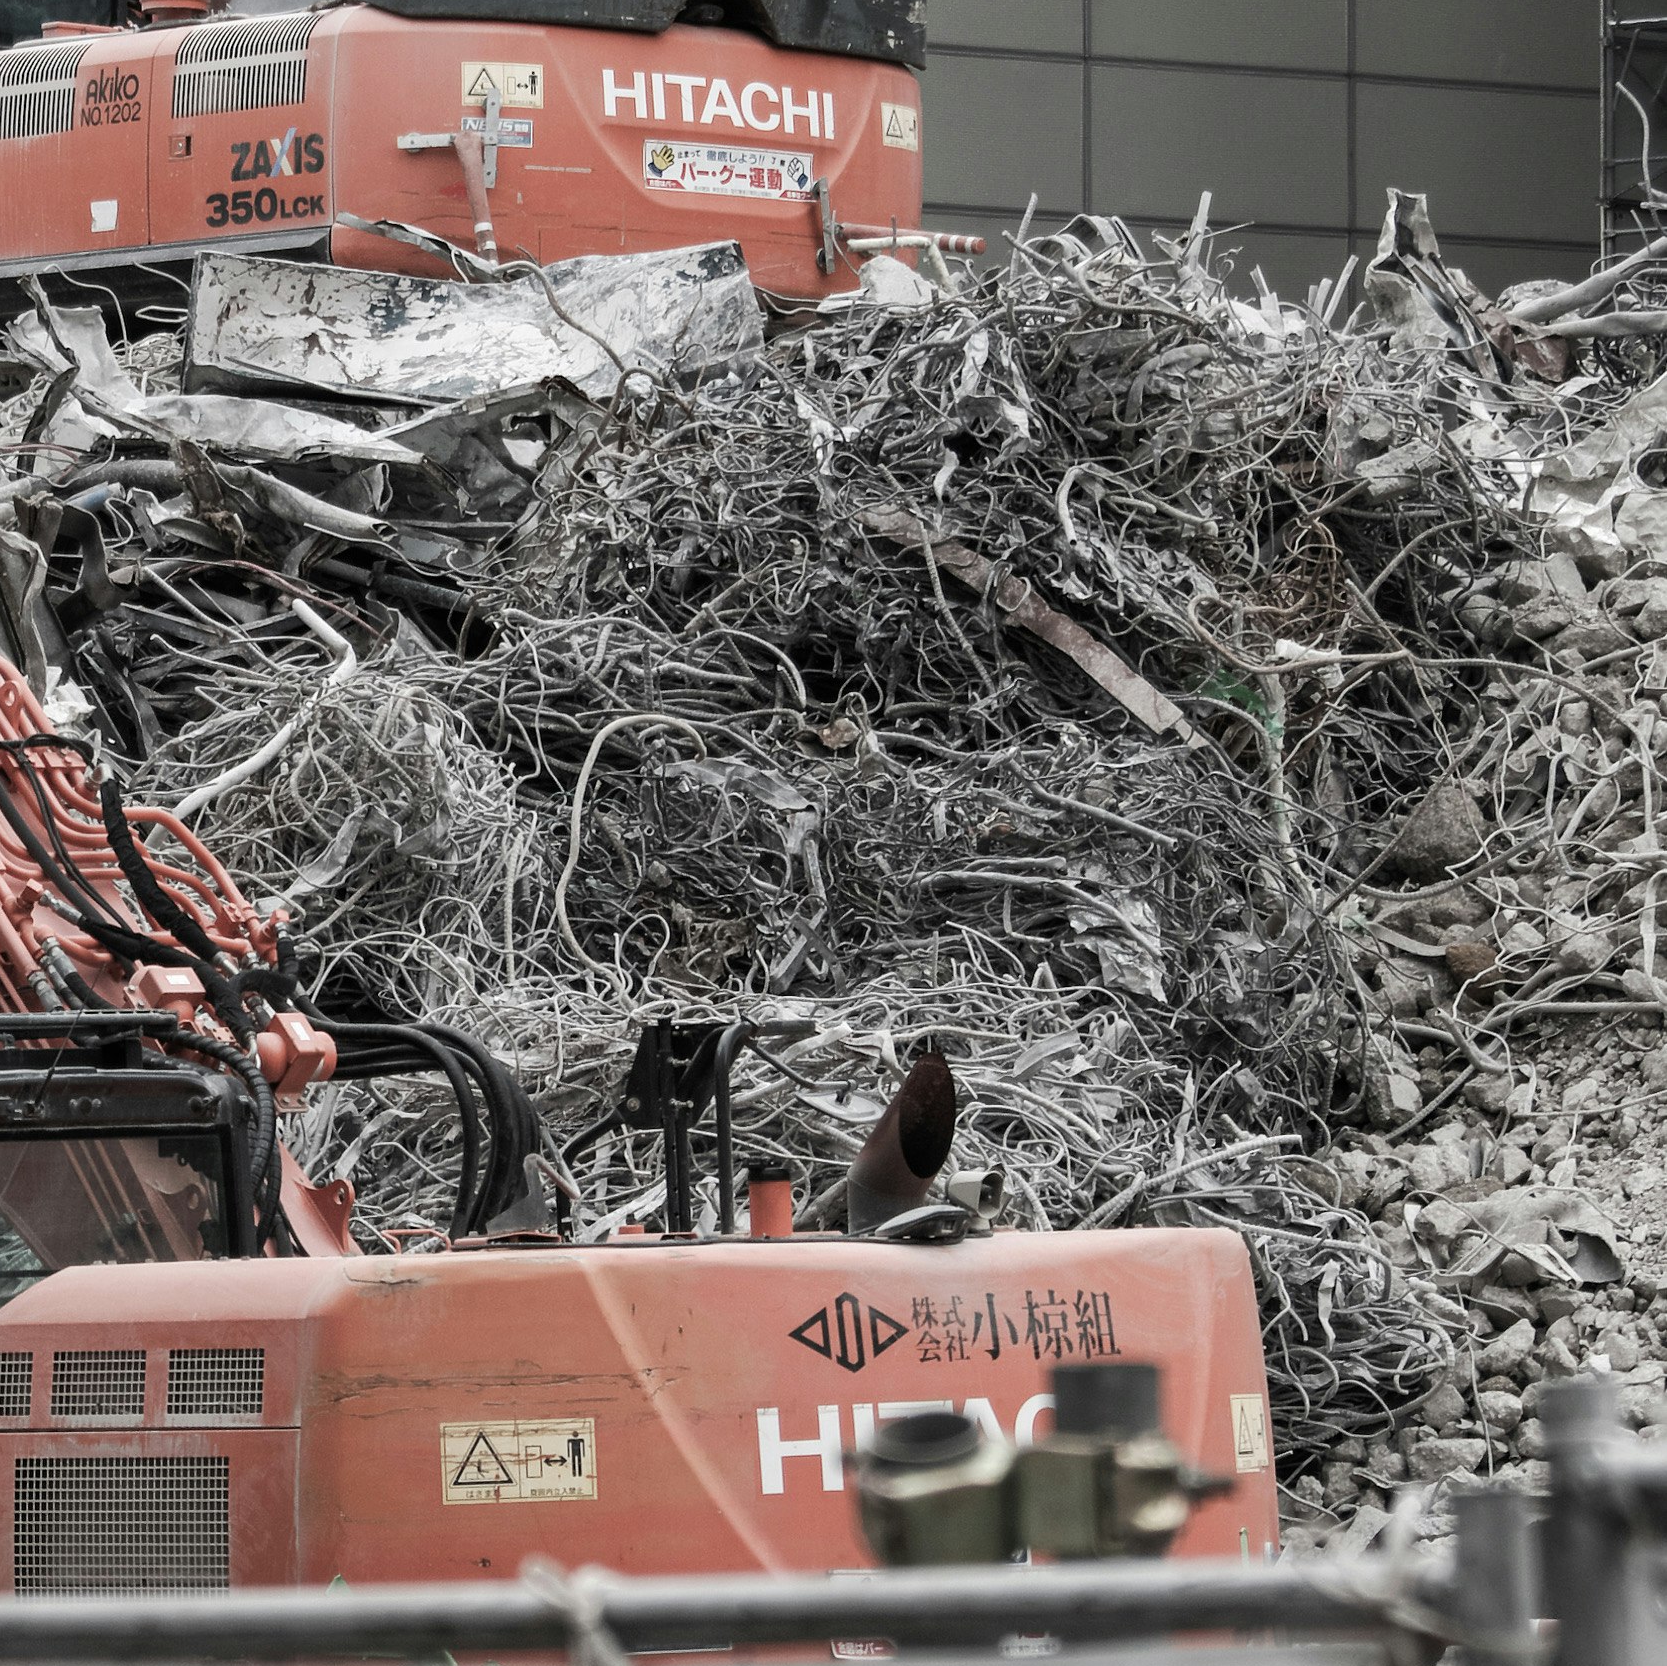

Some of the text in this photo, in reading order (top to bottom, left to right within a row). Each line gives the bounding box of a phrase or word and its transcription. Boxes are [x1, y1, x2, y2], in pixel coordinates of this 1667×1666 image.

[466, 119, 514, 132] NEIS
[602, 69, 834, 140] HITACHI
[231, 126, 325, 182] ZAXIS
